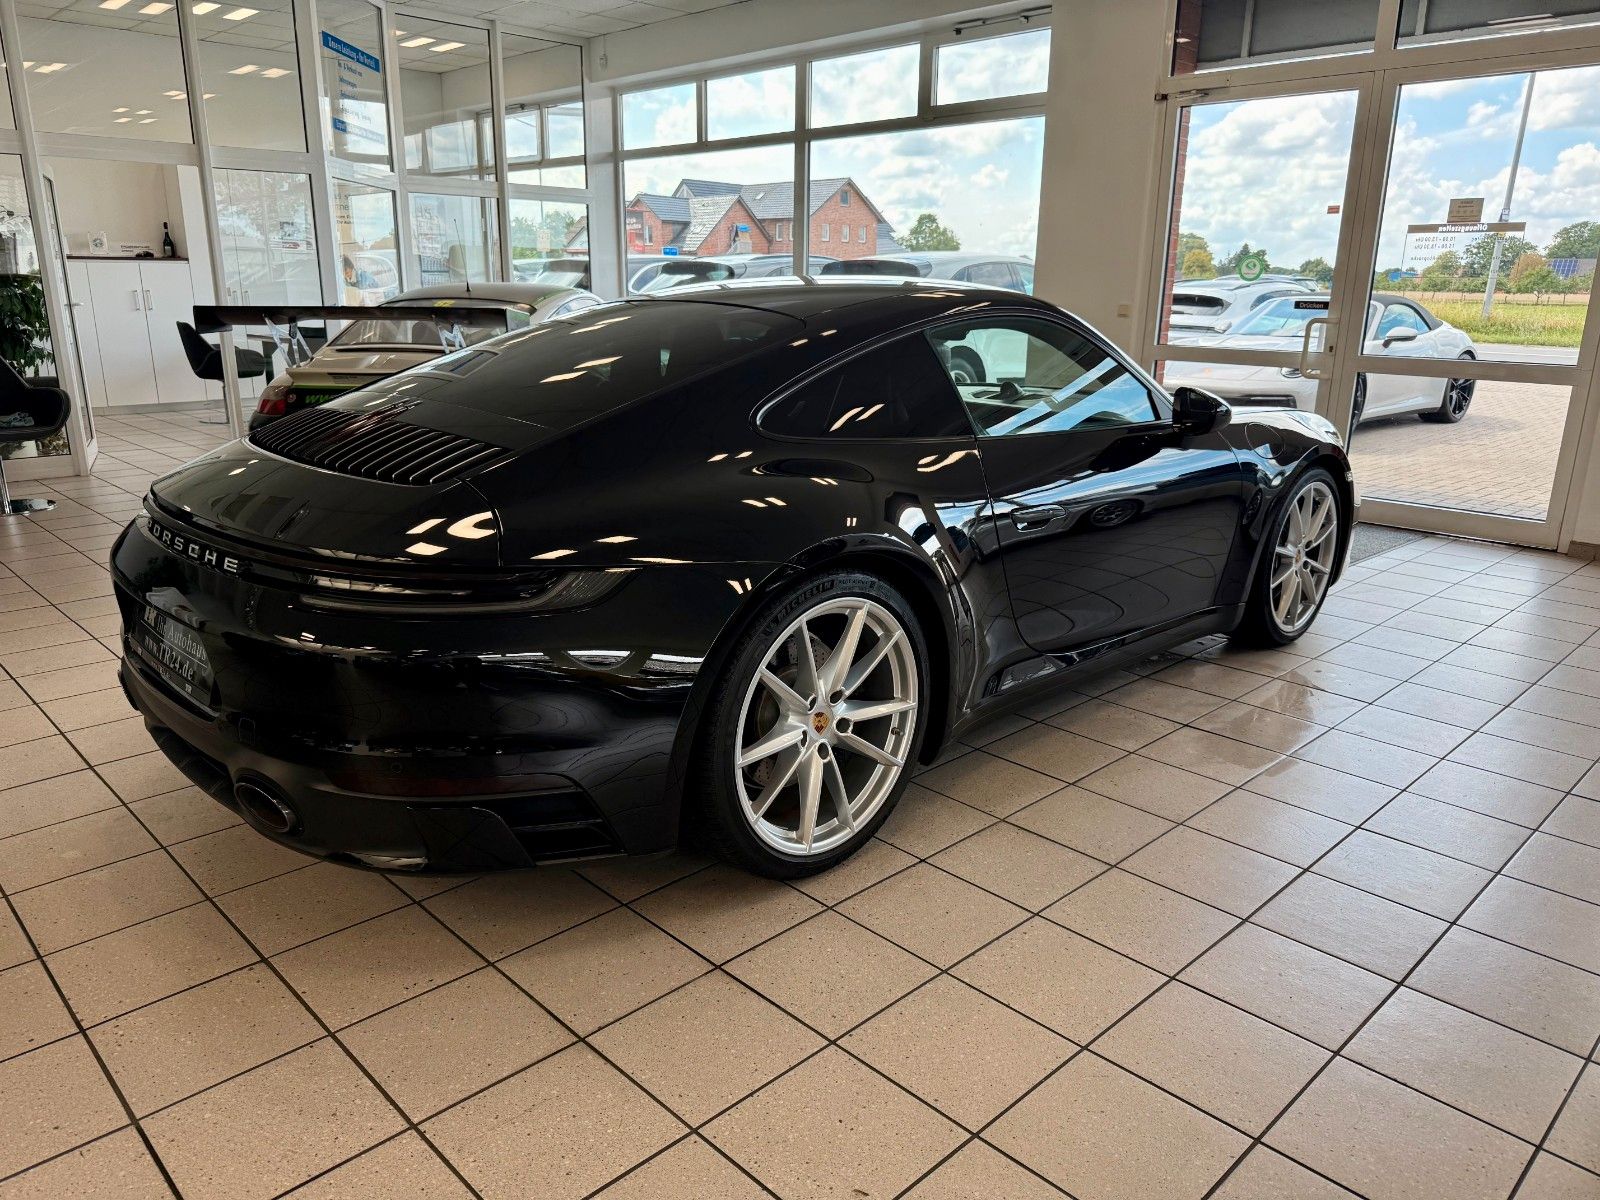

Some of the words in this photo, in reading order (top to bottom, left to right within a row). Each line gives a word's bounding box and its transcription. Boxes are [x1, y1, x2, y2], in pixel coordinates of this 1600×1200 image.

[147, 519, 239, 573] PORSCHE
[776, 580, 834, 623] MICHELIN
[144, 635, 194, 681] www.TR24.de
[167, 623, 207, 661] Autohaus
